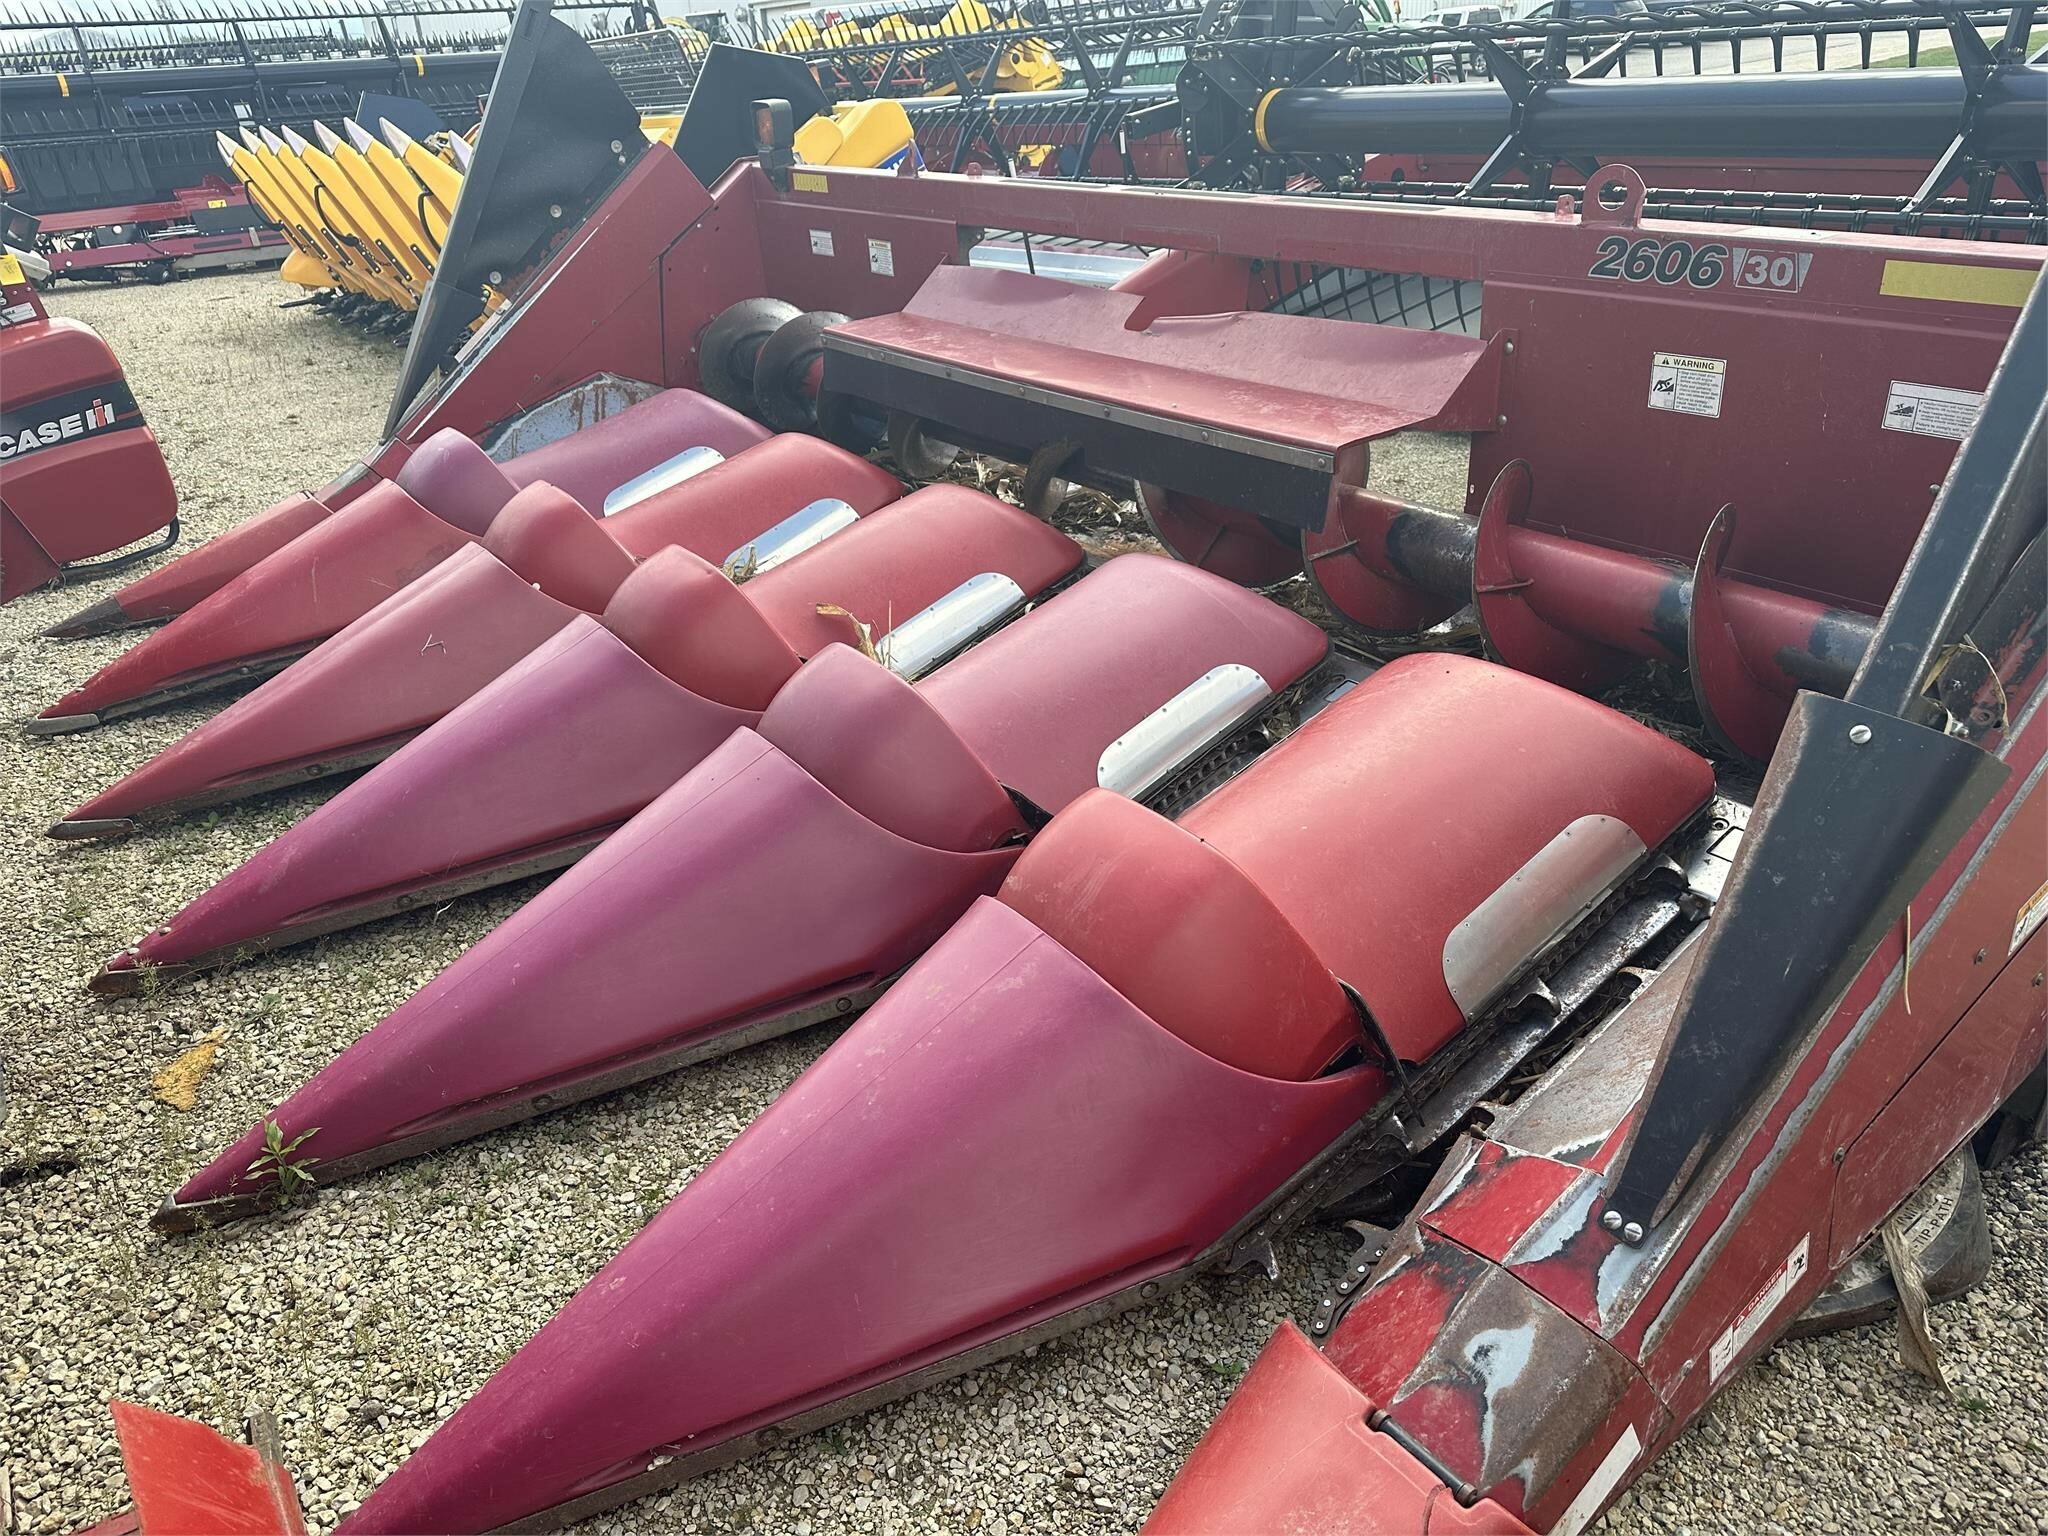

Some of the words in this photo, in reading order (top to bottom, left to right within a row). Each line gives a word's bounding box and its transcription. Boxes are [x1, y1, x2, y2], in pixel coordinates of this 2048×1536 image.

[1588, 235, 1729, 288] 2606
[1745, 256, 1794, 287] 30
[1673, 358, 1715, 370] WARNING
[0, 413, 83, 458] CASE
[1748, 1268, 1782, 1311] DANGER
